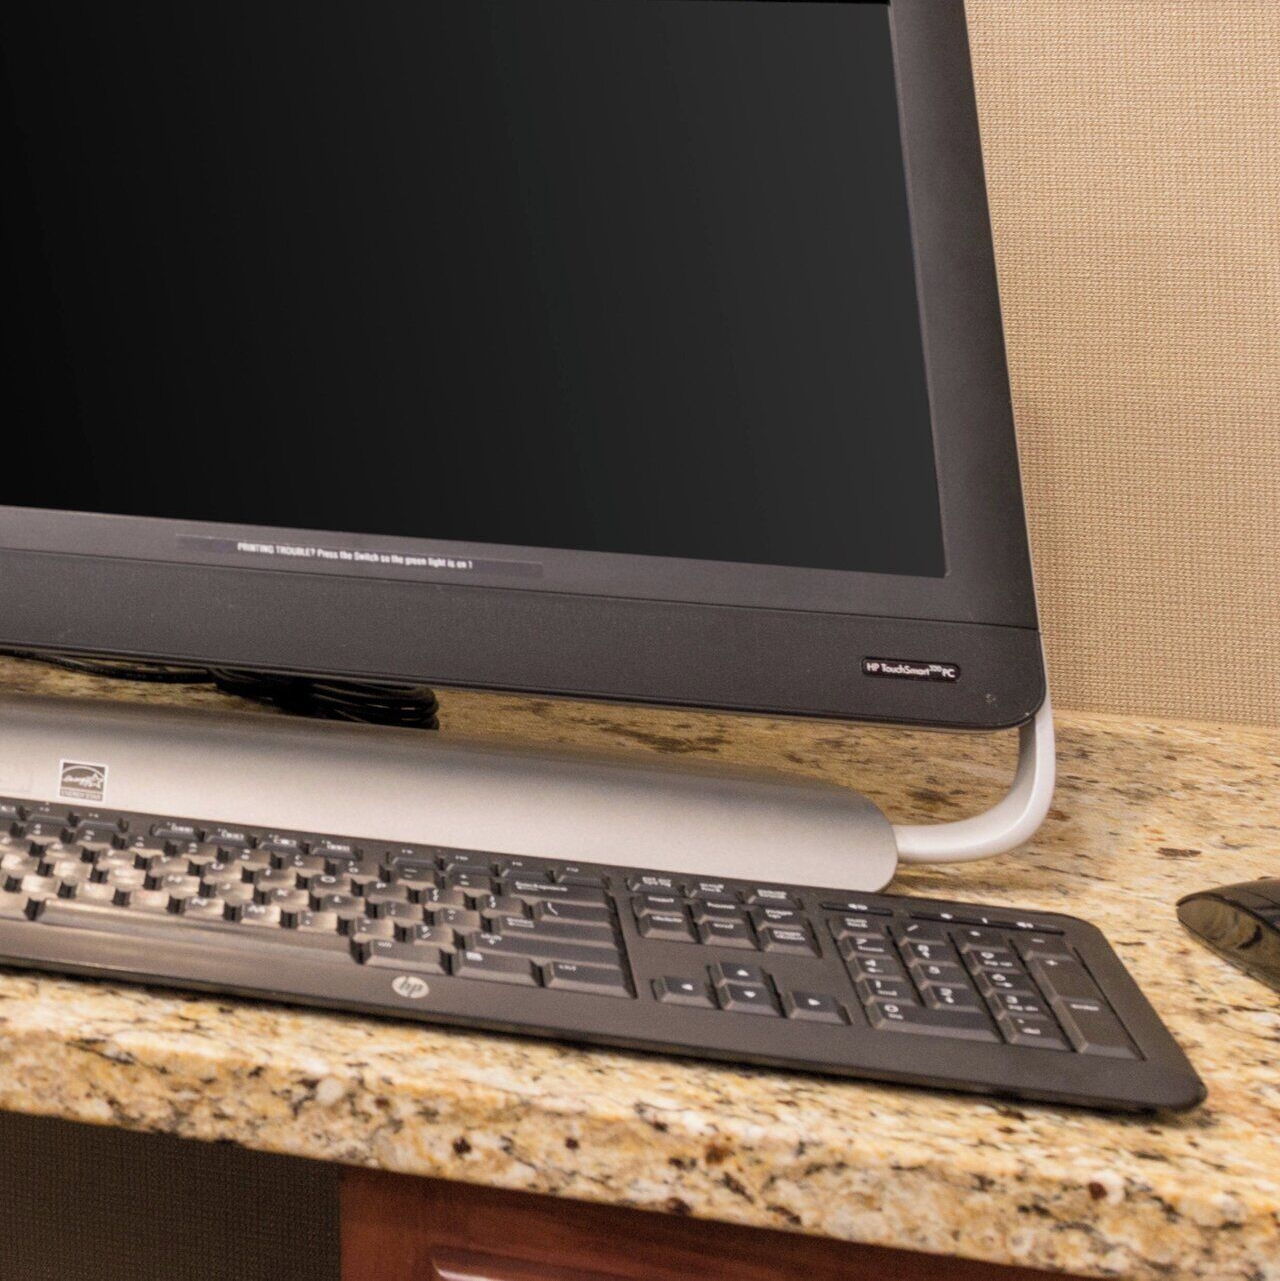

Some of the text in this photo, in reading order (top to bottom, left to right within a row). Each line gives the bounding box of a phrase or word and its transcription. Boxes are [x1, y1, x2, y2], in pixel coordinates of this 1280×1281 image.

[237, 542, 275, 554] PRINTING
[276, 544, 316, 558] TROUBLE?
[317, 547, 338, 560] Press
[339, 549, 353, 561] the
[354, 550, 379, 563] Switch
[380, 554, 390, 564] so
[391, 553, 403, 565] the
[405, 556, 427, 567] green
[428, 556, 446, 568] light
[456, 560, 467, 569] on
[866, 662, 880, 672] HP
[881, 663, 930, 676] TouchSmart
[941, 668, 956, 678] PC
